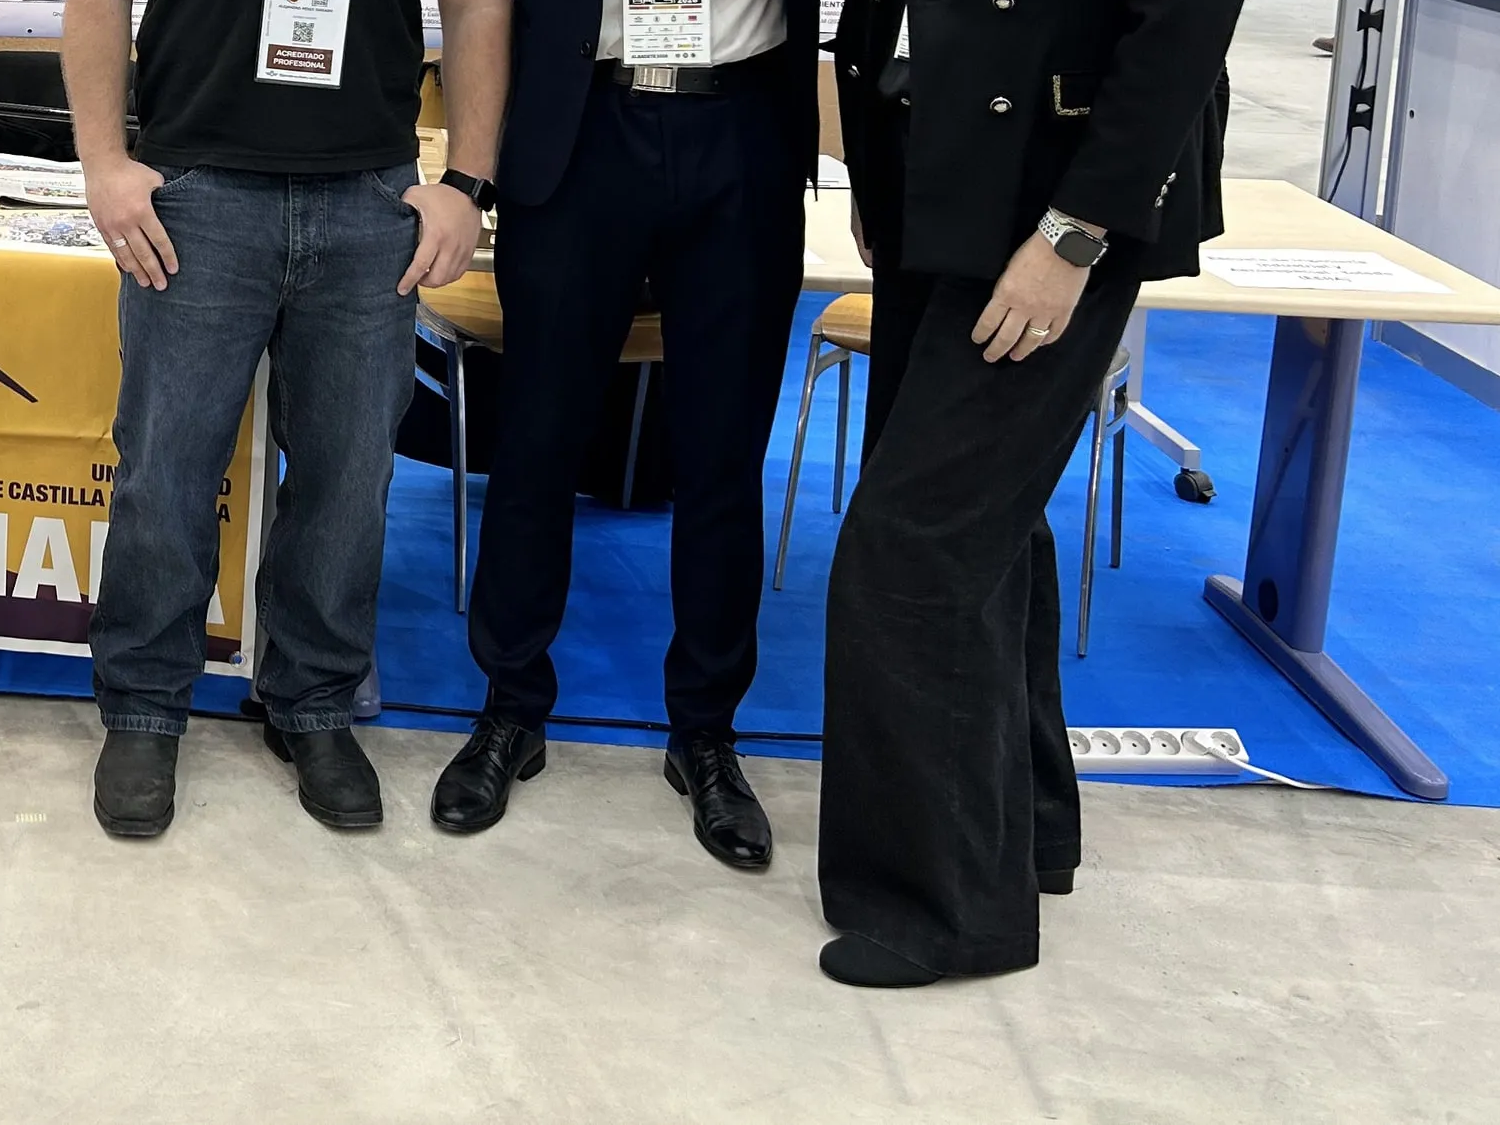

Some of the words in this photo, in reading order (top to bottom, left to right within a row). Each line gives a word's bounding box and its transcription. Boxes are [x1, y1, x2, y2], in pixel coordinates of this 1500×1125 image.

[276, 49, 325, 60] ACREDITADO
[273, 58, 326, 69] PROFESIONAL
[8, 481, 105, 507] CASTILLA
